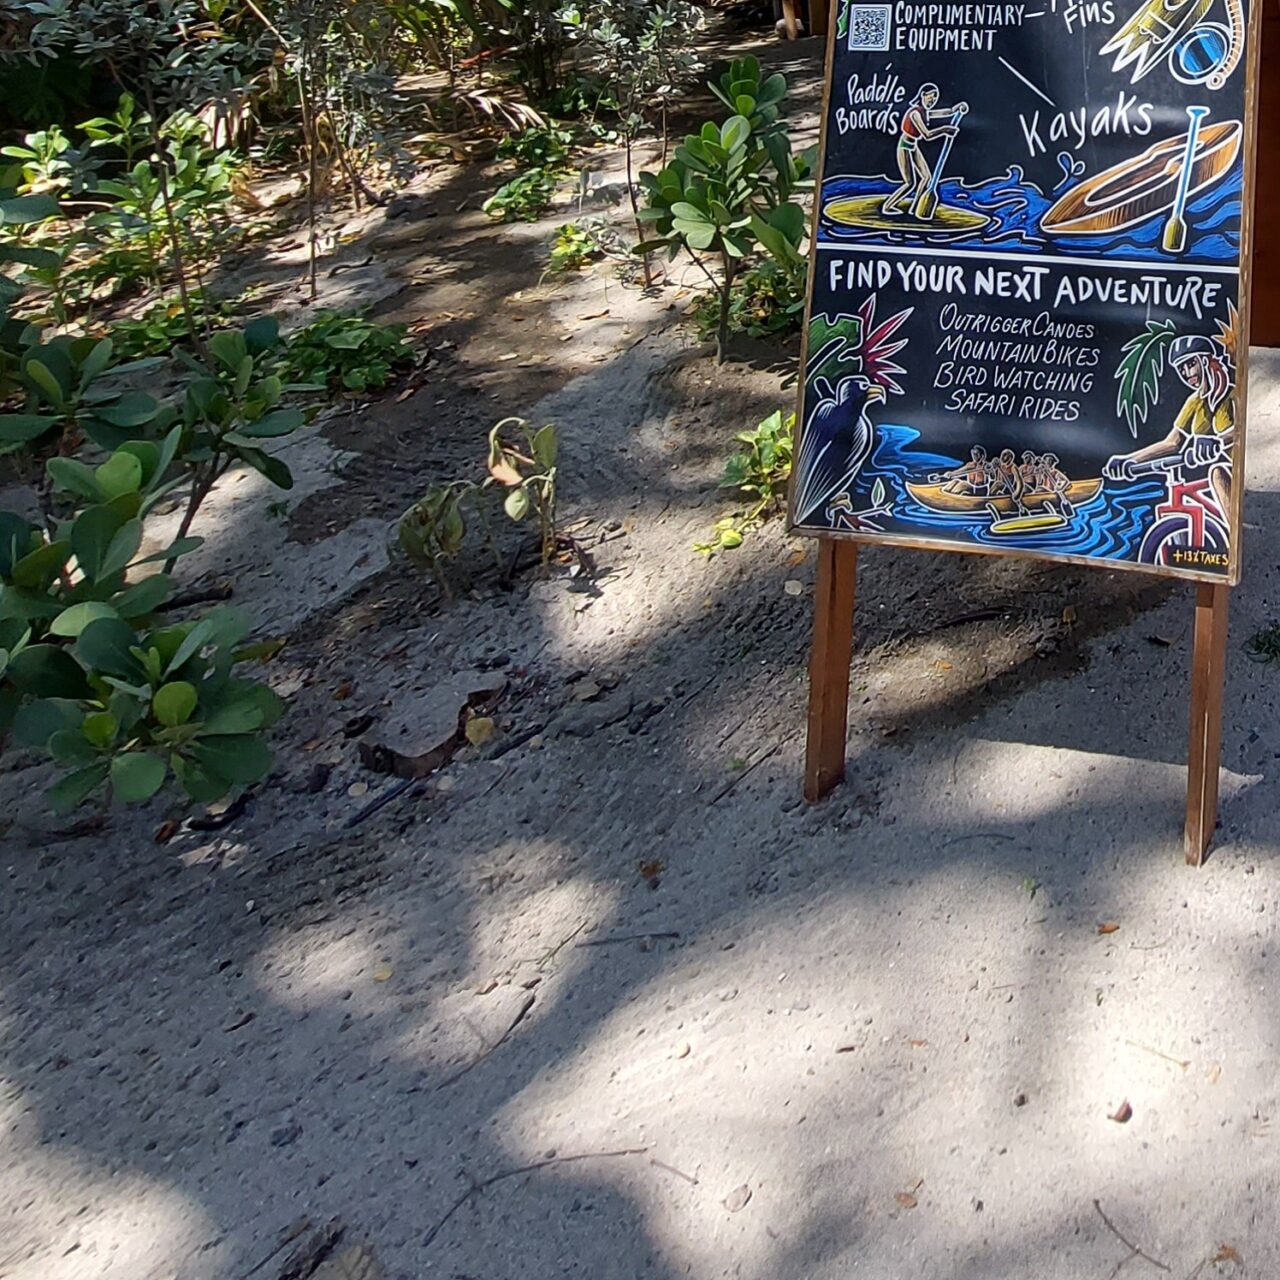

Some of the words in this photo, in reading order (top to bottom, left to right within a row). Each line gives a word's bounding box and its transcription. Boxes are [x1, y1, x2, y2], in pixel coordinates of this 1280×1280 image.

[1063, 0, 1115, 34] Fins
[895, 27, 997, 52] EQUIPMENT
[847, 73, 906, 106] Paddle
[836, 102, 900, 135] Boards
[829, 260, 892, 292] FIND
[896, 261, 966, 295] YOUR
[974, 266, 1050, 302] NEXT
[1053, 274, 1222, 319] ADVENTURE
[939, 303, 1032, 337] OUTRIGGER
[1032, 311, 1095, 339] CANOES
[935, 334, 1042, 364] MOUNTAIN
[1042, 339, 1101, 368] BIKES
[933, 361, 988, 388] BIRD
[993, 365, 1095, 393] WATCHING
[944, 389, 1016, 416] SAFARI
[1018, 396, 1081, 421] RIDES
